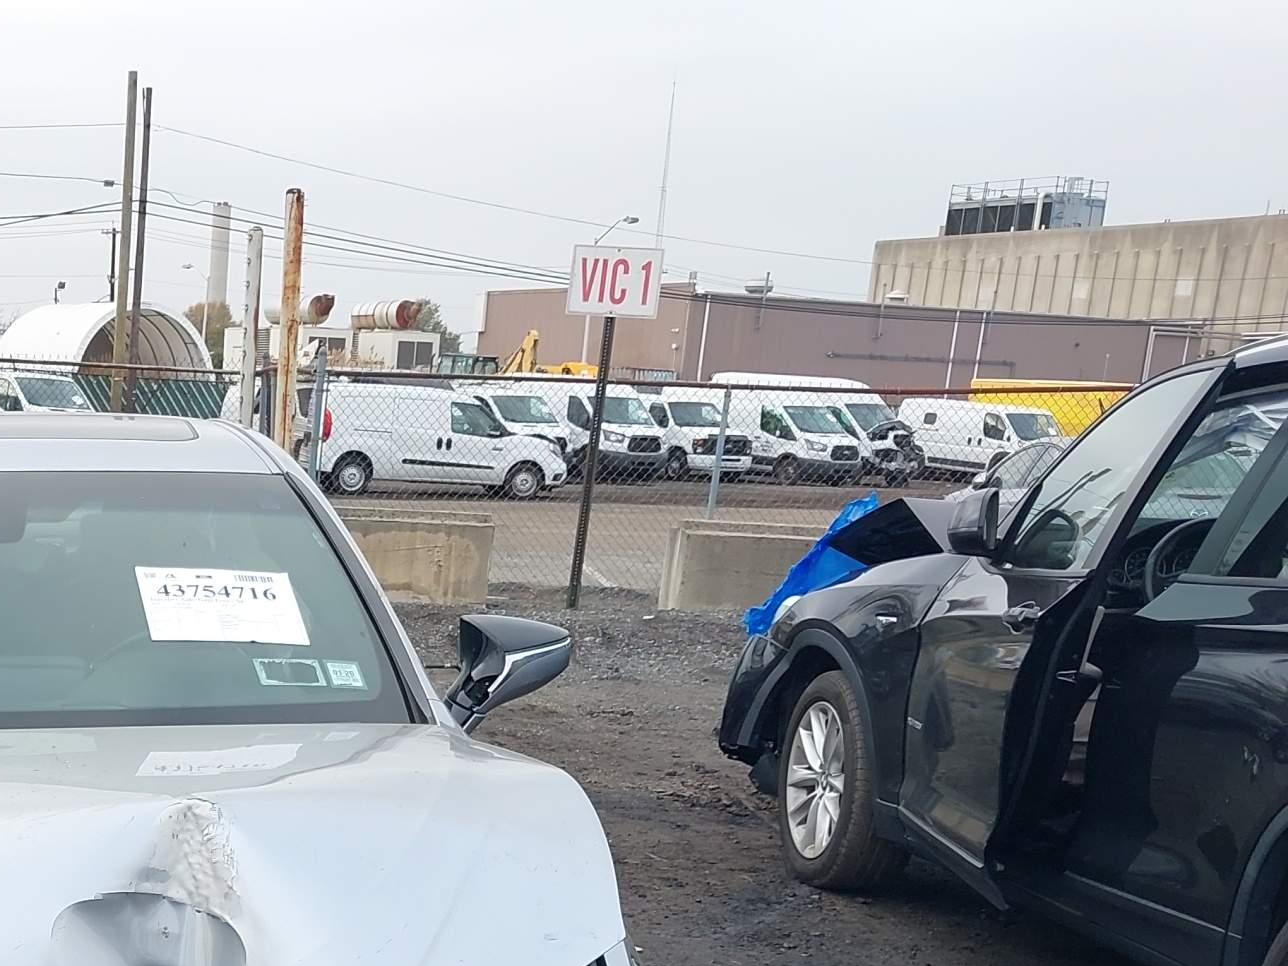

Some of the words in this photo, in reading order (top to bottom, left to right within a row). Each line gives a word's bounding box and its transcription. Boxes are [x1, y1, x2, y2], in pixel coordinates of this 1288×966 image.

[581, 257, 630, 305] VIC
[640, 260, 653, 306] 1
[156, 584, 277, 601] 43754716
